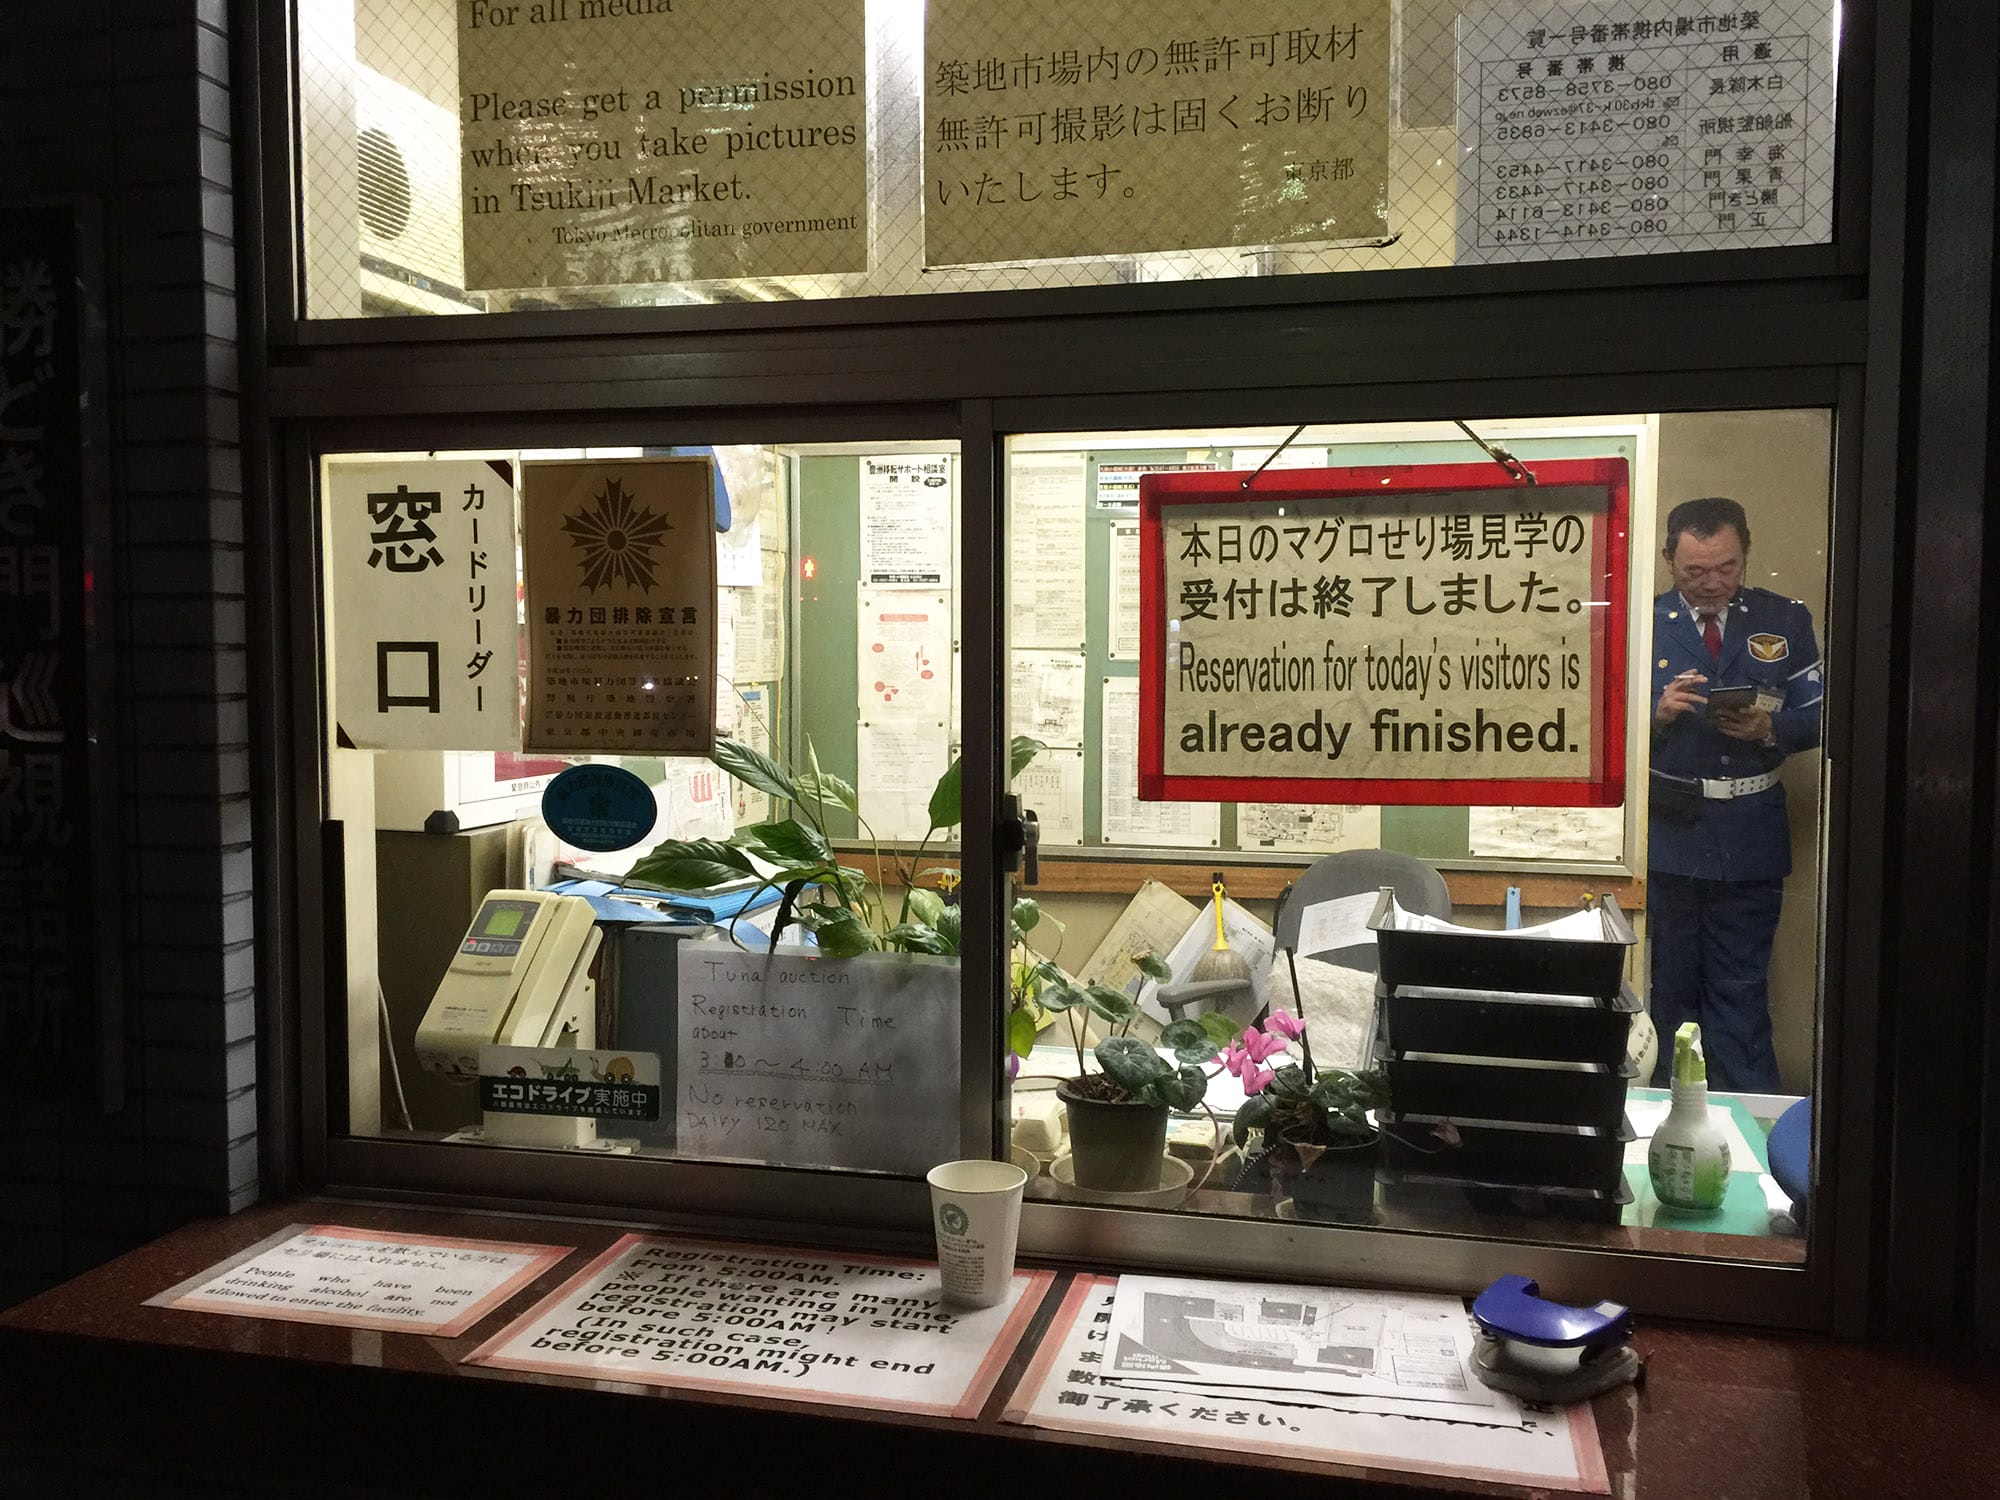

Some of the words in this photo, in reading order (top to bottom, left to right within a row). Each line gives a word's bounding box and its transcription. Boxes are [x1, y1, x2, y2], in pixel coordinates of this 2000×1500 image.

[469, 0, 519, 29] For
[529, 0, 568, 24] all
[578, 0, 673, 20] media
[935, 22, 1365, 97] 築地市場内の無許可取材
[470, 92, 569, 122] Please
[583, 88, 629, 121] get
[645, 91, 663, 110] a
[678, 70, 857, 112] permission
[936, 84, 1370, 153] 無許可撮影は固くお断り
[471, 139, 552, 168] when
[568, 138, 622, 168] you
[640, 126, 708, 158] take
[724, 119, 857, 160] pictures
[937, 162, 1135, 206] いたします。
[1287, 156, 1355, 182] 東京都
[472, 187, 501, 214] in
[511, 179, 616, 212] Tsukiji
[628, 174, 751, 206] Market.
[552, 226, 606, 247] Tokyo
[612, 220, 736, 243] Metropolitan
[741, 214, 858, 241] government
[1180, 512, 1584, 568] 本日のマグロせり場見学の
[366, 484, 445, 714] 窓口
[462, 483, 493, 712] カードリーダー
[1179, 571, 1583, 621] 受付は終了しました。
[544, 606, 698, 625] 暴力団排除宣言
[1180, 640, 1315, 693] Reservation
[1326, 640, 1358, 692] for
[1365, 637, 1450, 701] today's
[1461, 637, 1550, 692] visitors
[1561, 637, 1580, 690] is
[1180, 709, 1351, 760] already
[1371, 707, 1579, 753] finished.
[704, 961, 762, 983] Tuna
[779, 971, 849, 985] auction
[692, 994, 808, 1020] Registration
[837, 1006, 897, 1029] Time
[692, 1027, 738, 1041] about
[790, 1057, 844, 1077] 4:00
[858, 1062, 893, 1081] AM
[492, 1083, 648, 1108] エコドライブ実施中
[689, 1085, 723, 1106] No
[757, 1116, 790, 1131] 120
[245, 1267, 296, 1279] People
[318, 1275, 351, 1285] who
[373, 1280, 412, 1291] have
[436, 1285, 474, 1297] been
[630, 1259, 706, 1273] From
[716, 1266, 840, 1286] 5:00AM.
[644, 1247, 828, 1272] Registration
[842, 1265, 927, 1281] Time:
[205, 1288, 270, 1301] allowed
[271, 1293, 287, 1302] to
[289, 1296, 333, 1308] enter
[335, 1300, 364, 1310] the
[365, 1303, 425, 1317] facility.
[225, 1278, 295, 1292] drinking
[309, 1286, 369, 1298] alcohol
[384, 1294, 412, 1303] are
[431, 1296, 459, 1307] not
[600, 1282, 707, 1299] people
[719, 1292, 837, 1313] waiting
[849, 1302, 879, 1315] in
[891, 1306, 959, 1325] line,
[657, 1273, 690, 1284] If
[696, 1276, 778, 1293] there
[788, 1287, 840, 1299] are
[851, 1292, 940, 1311] many
[576, 1301, 681, 1320] before
[691, 1312, 816, 1334] 5:00AM
[590, 1292, 779, 1318] registration
[790, 1311, 860, 1327] may
[870, 1318, 953, 1334] start
[576, 1316, 628, 1330] (In
[638, 1322, 715, 1338] such
[727, 1332, 810, 1350] case,
[530, 1337, 641, 1358] before
[651, 1350, 811, 1378] 5:00AM.)
[545, 1328, 744, 1355] registration
[756, 1348, 860, 1369] might
[870, 1359, 936, 1375] end
[1058, 1390, 1301, 1432] 御了承ください。
